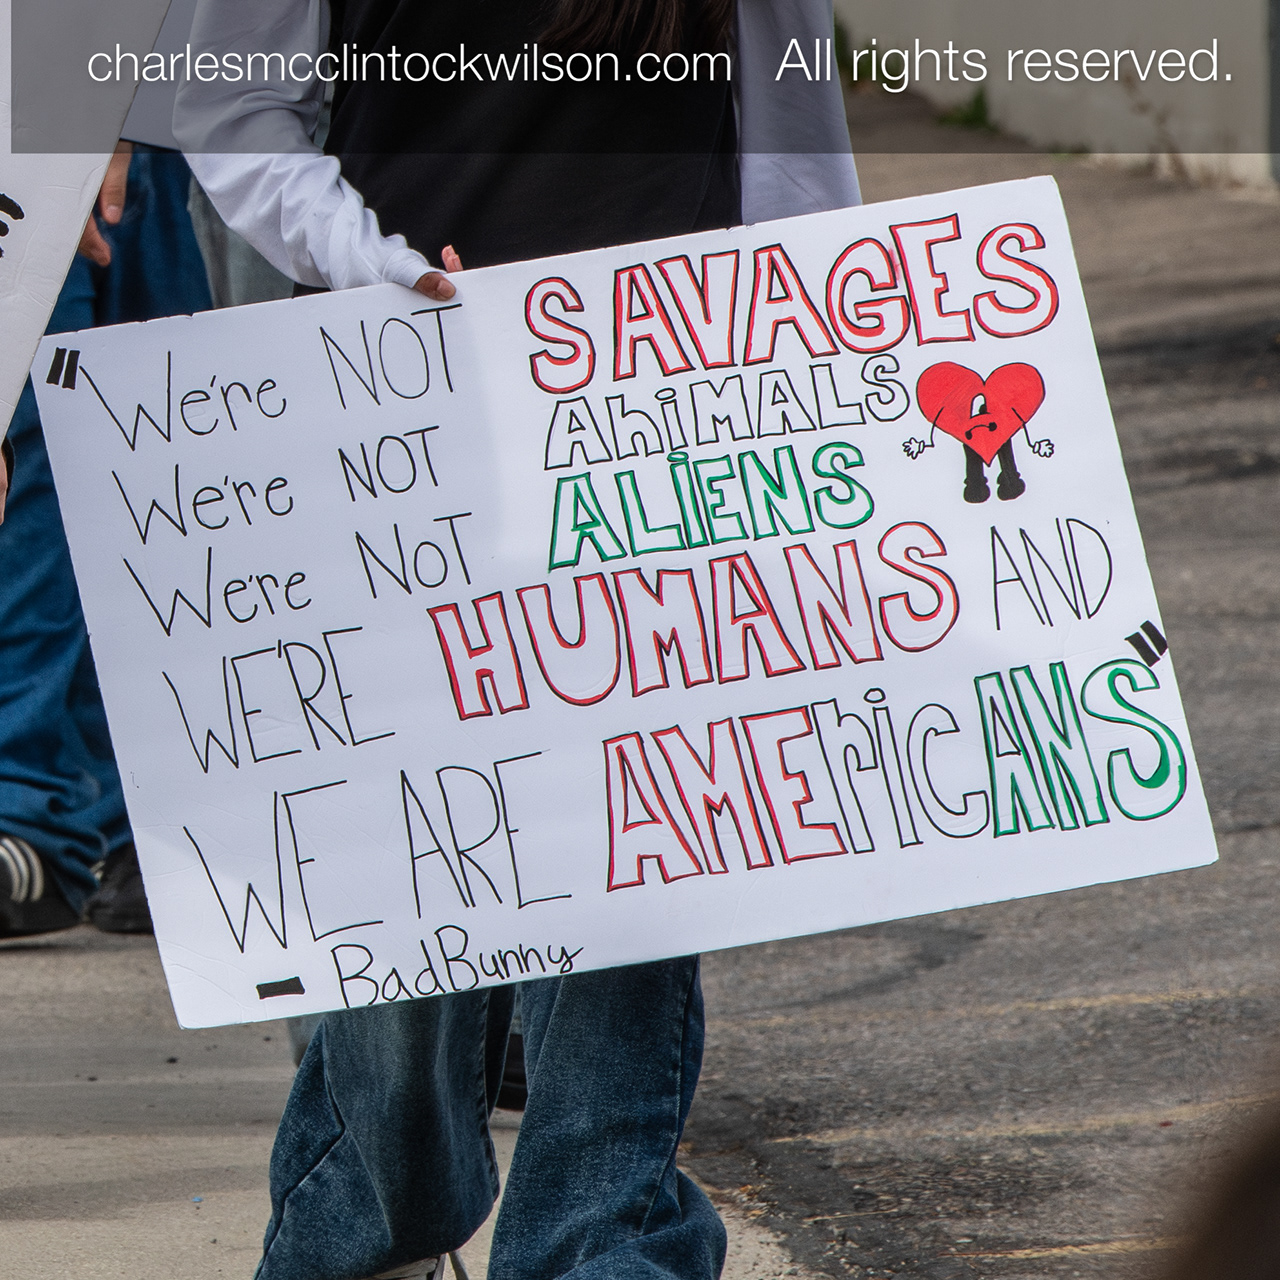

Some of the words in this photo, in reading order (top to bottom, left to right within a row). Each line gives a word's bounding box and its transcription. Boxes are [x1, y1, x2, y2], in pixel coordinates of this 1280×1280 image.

[320, 303, 462, 410] NOT
[525, 214, 1059, 394] SAVAGES
[112, 464, 293, 545] We're
[338, 426, 439, 502] NOT
[160, 624, 396, 774] WE'RE
[426, 521, 960, 721] HUMANS
[990, 517, 1113, 631] AND
[183, 780, 384, 953] WE
[400, 750, 572, 919] ARE
